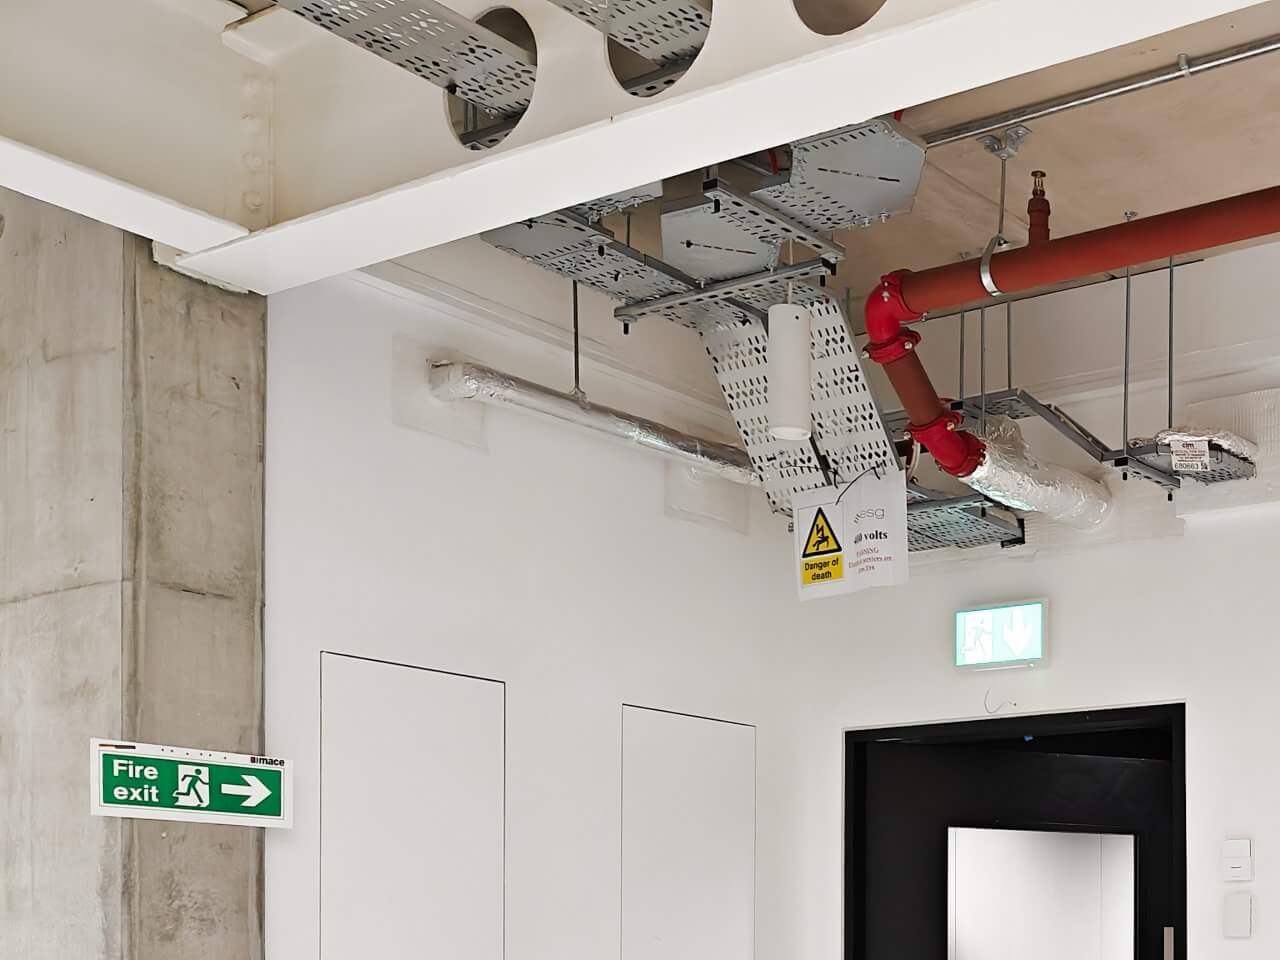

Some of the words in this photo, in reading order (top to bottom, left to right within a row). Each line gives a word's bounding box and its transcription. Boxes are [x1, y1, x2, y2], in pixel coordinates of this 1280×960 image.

[863, 530, 888, 540] volts
[804, 560, 830, 571] Danger
[831, 557, 839, 566] of
[811, 570, 832, 581] death
[259, 757, 285, 767] mace
[112, 759, 160, 780] Fire
[113, 784, 160, 803] exit
